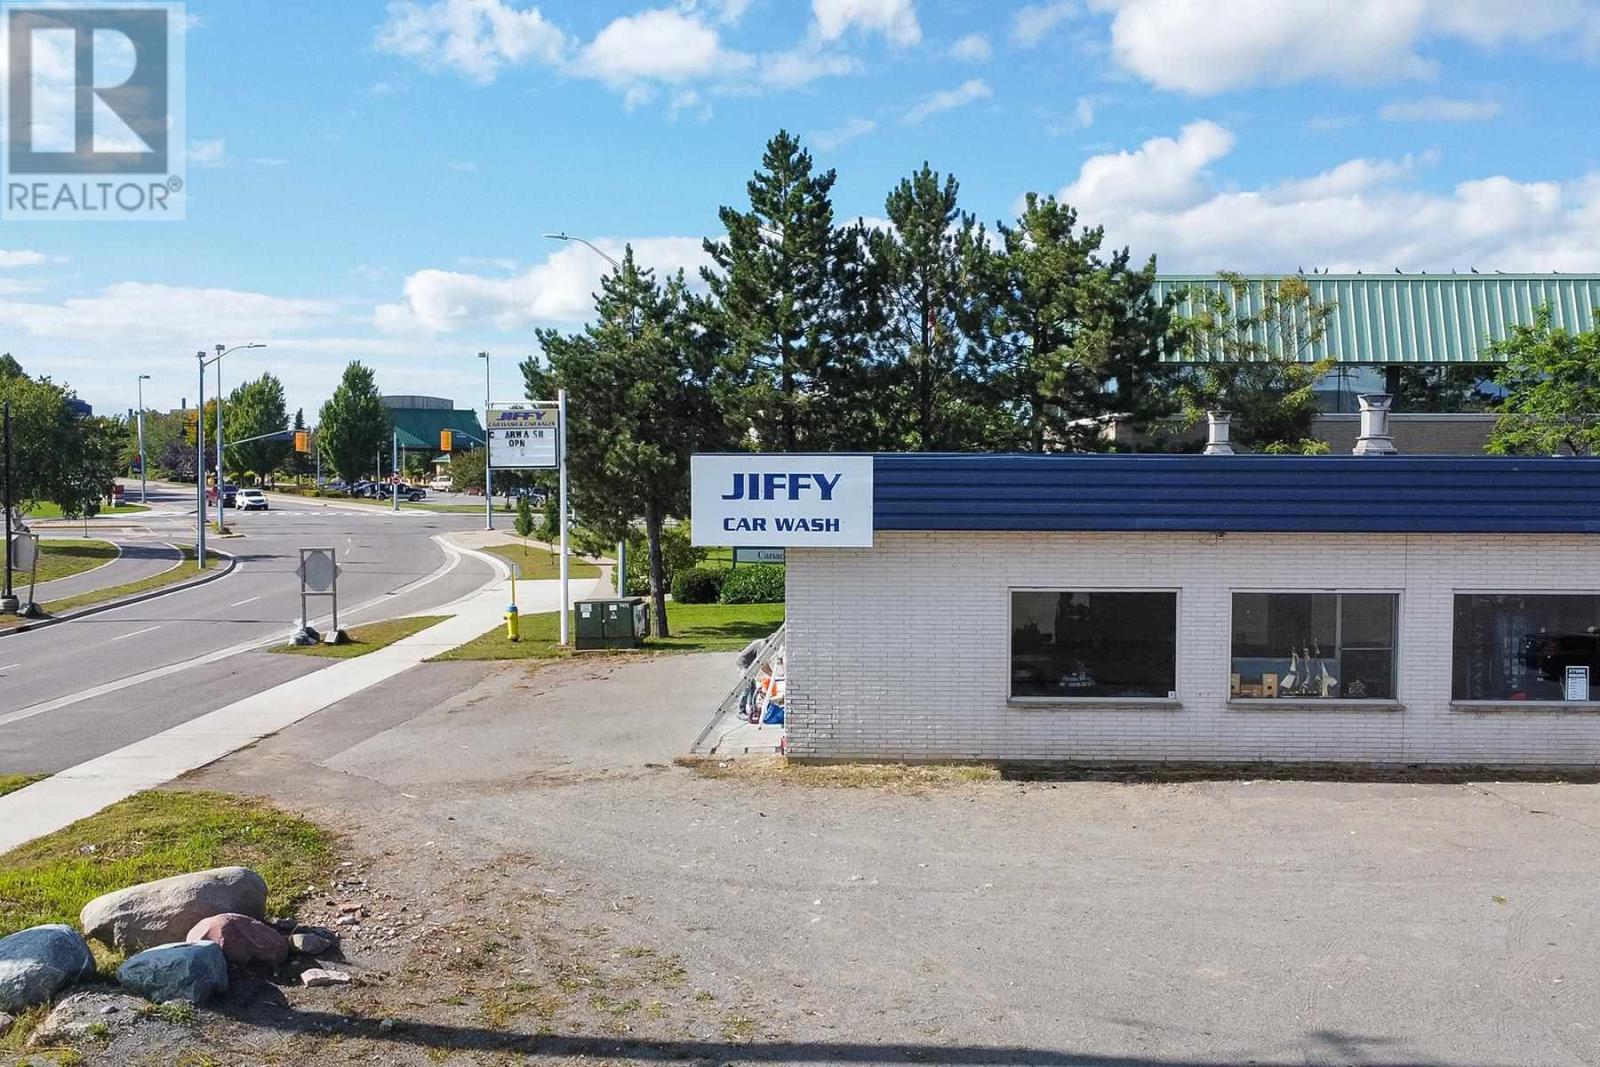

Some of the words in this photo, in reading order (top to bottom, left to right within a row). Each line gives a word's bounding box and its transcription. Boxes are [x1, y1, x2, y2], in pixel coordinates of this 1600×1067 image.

[496, 411, 546, 421] JIFFY
[721, 473, 842, 501] JIFFY
[723, 517, 767, 532] CAR
[775, 518, 840, 532] WASH
